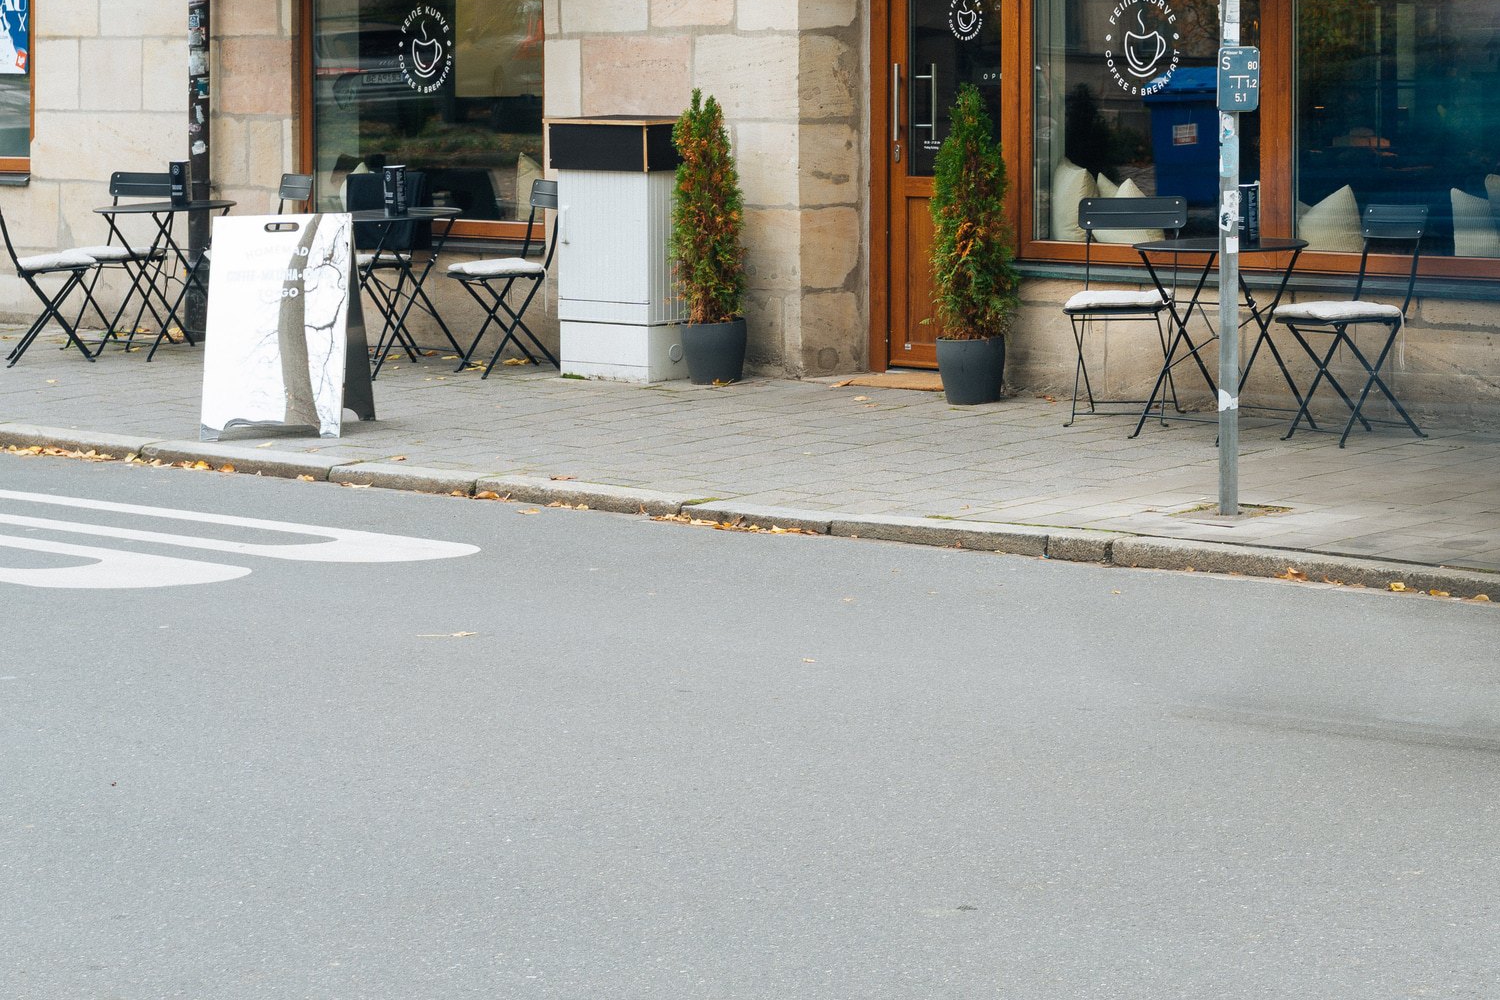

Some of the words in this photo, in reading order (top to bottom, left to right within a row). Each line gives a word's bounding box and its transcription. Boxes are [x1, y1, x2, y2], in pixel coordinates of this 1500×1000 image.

[401, 6, 422, 34] FEINE
[425, 6, 449, 33] KURVE
[398, 54, 416, 89] COFFEE
[424, 53, 452, 94] BREAKFAST
[1105, 50, 1129, 91] COFFEE
[1140, 49, 1180, 96] BREAKFAST
[1222, 56, 1231, 70] S
[1247, 61, 1258, 70] 80
